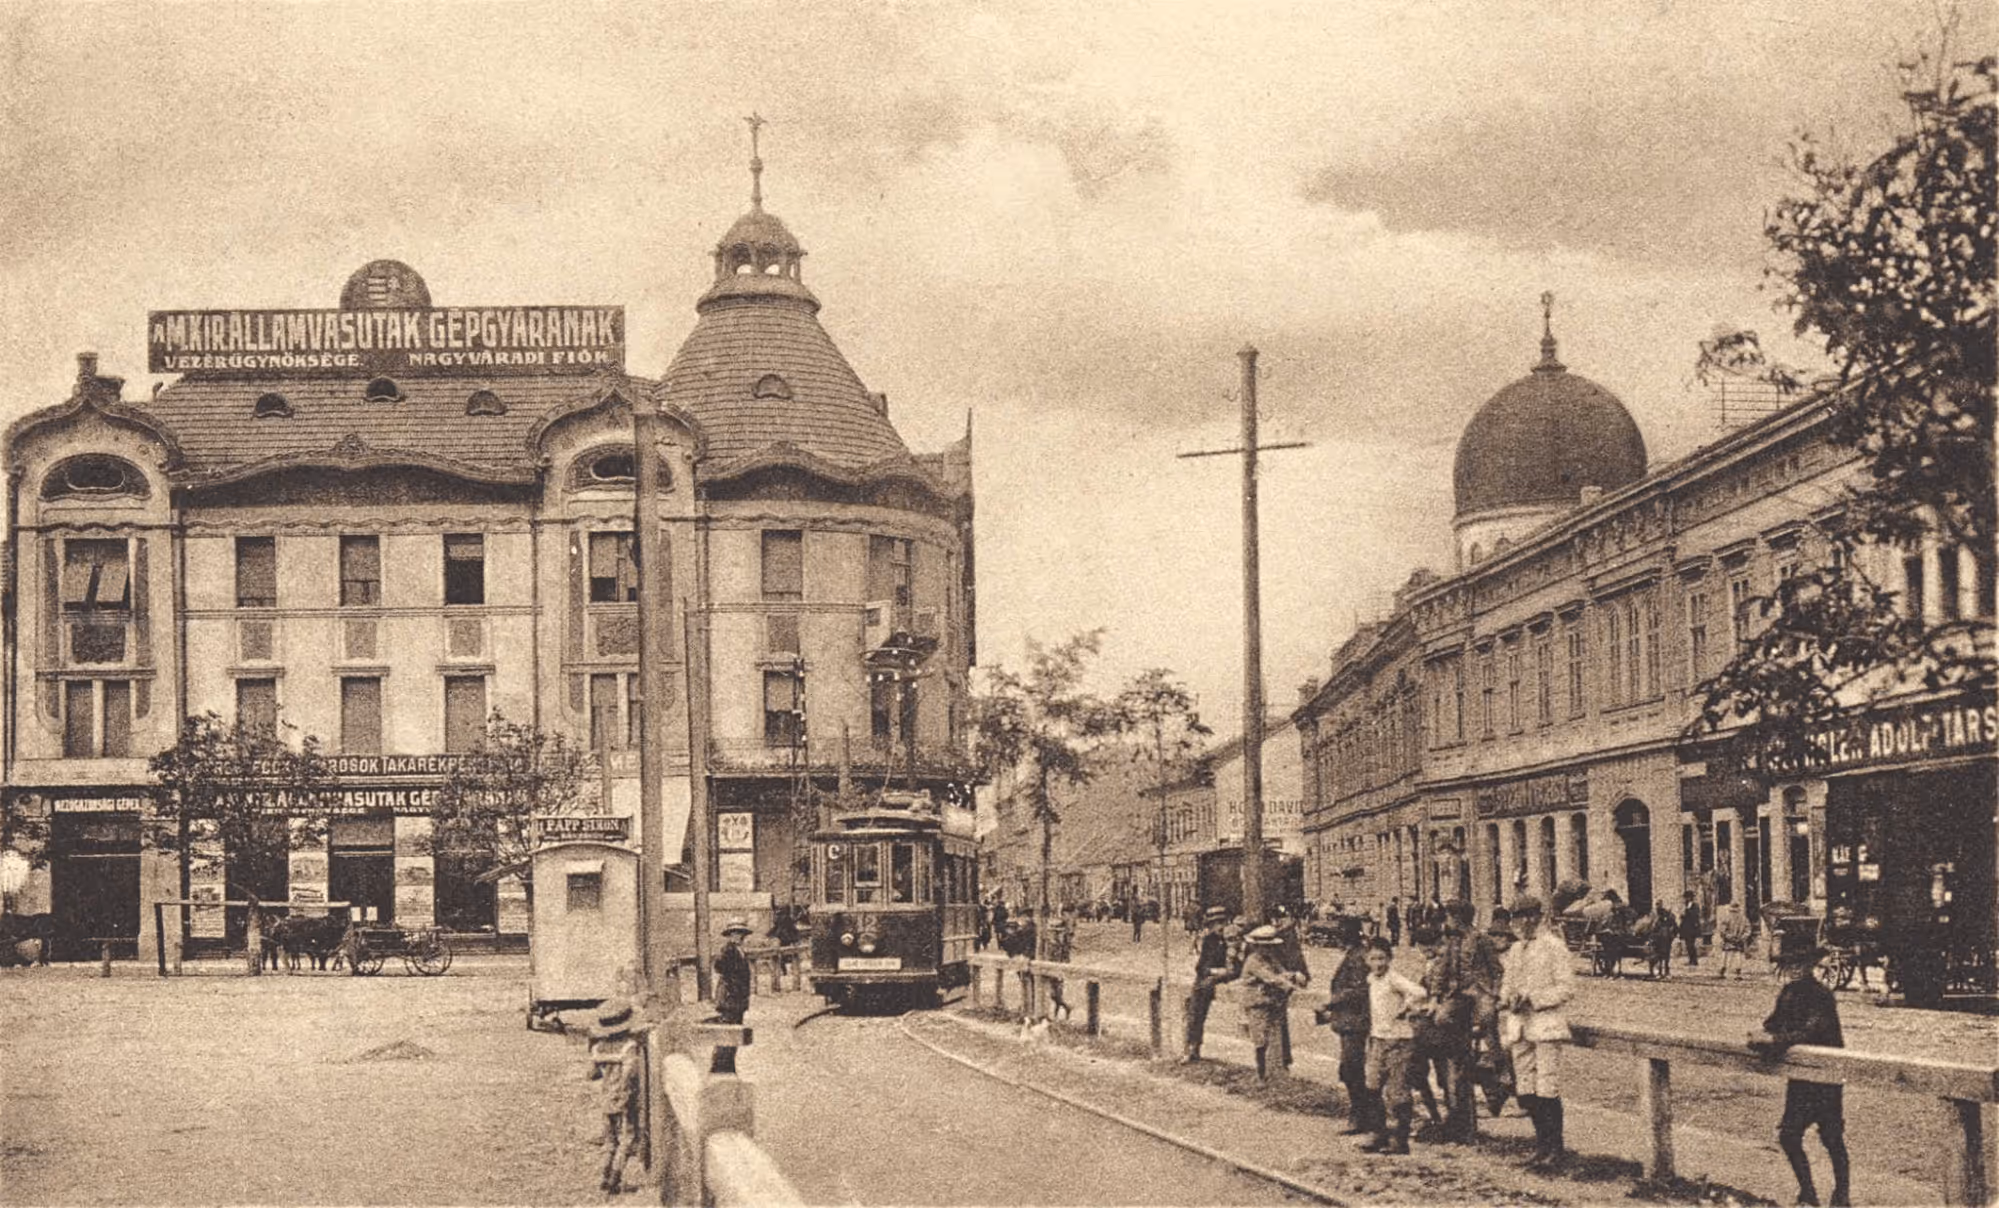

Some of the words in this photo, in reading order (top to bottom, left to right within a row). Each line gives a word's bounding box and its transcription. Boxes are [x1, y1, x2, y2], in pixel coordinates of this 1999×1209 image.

[429, 308, 615, 349] GÉPGYÁRÁNAK
[408, 349, 545, 366] NAGYVÁRADI
[552, 348, 608, 364] FIÓK
[546, 819, 580, 832] PAPP
